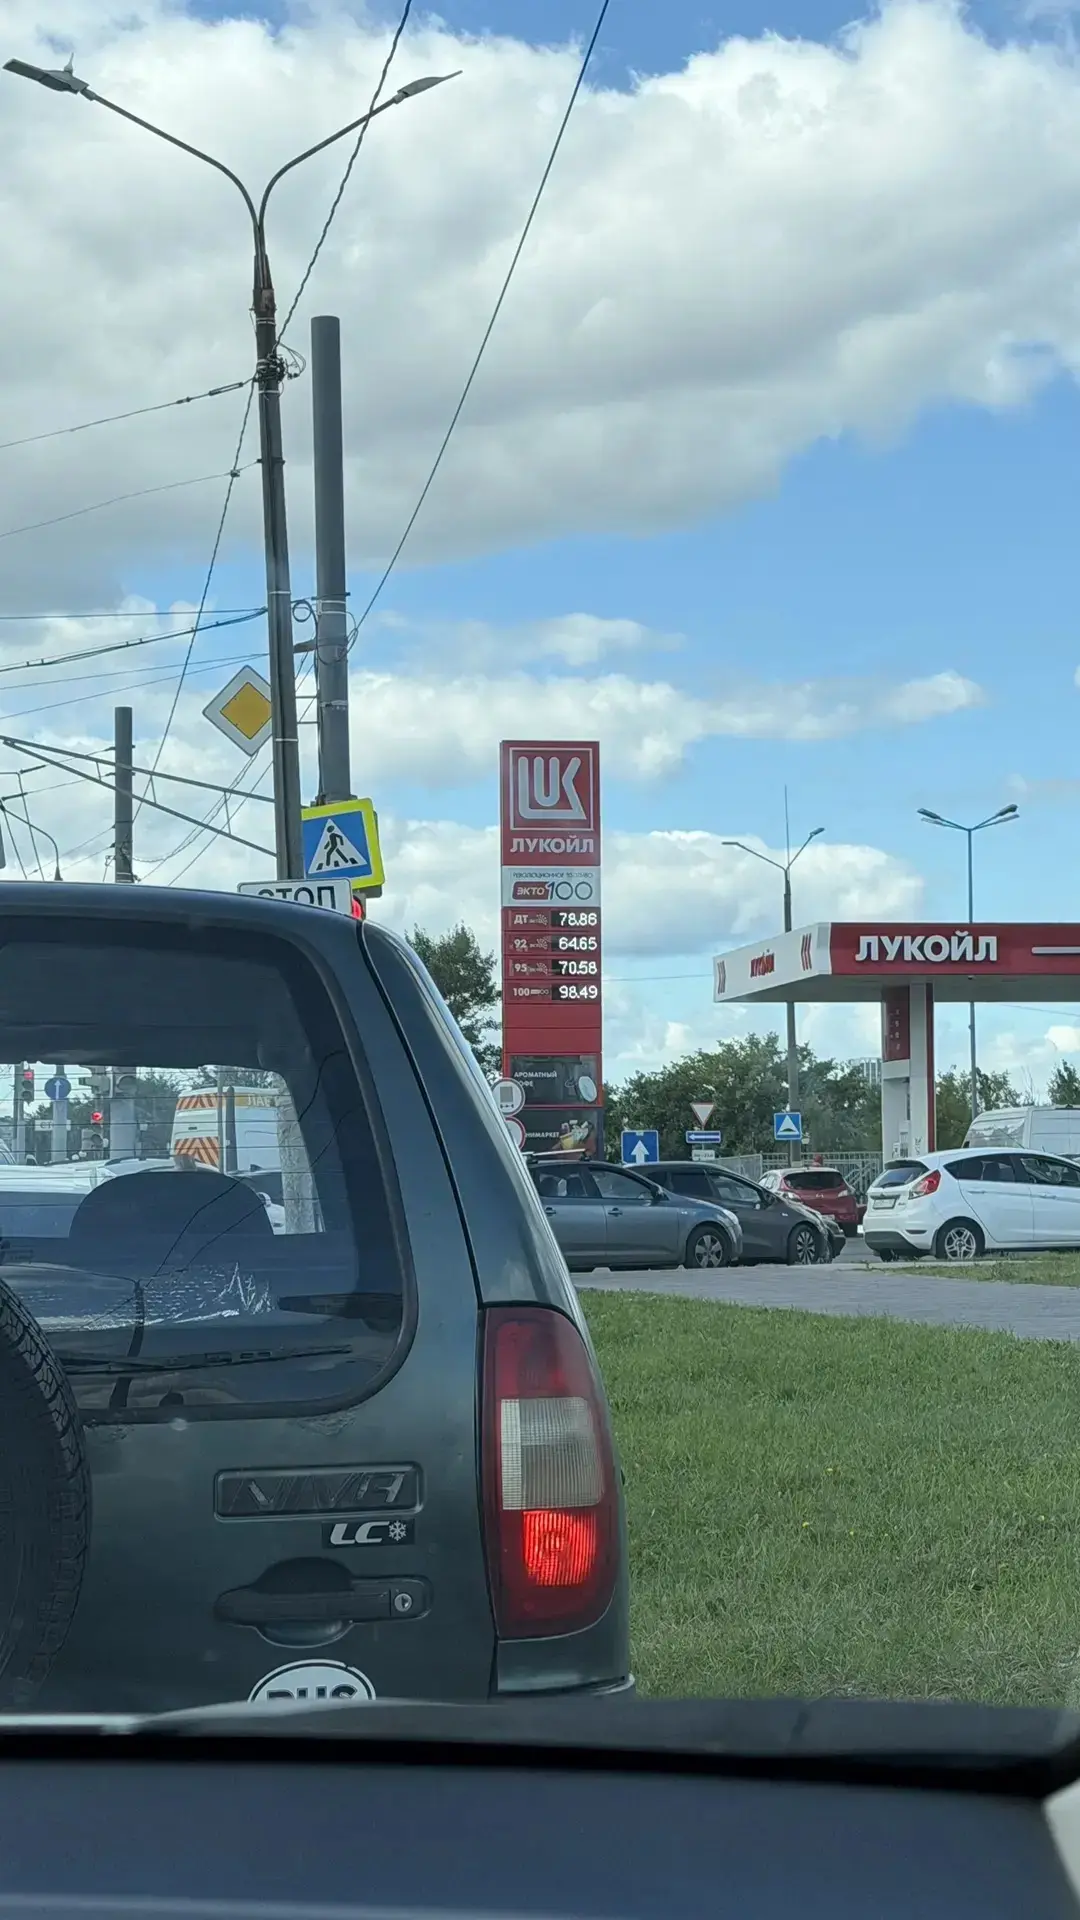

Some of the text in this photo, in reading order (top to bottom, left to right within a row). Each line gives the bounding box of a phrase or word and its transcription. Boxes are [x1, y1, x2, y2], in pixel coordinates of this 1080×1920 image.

[510, 835, 594, 853] ЛУКОЙЛ
[517, 887, 545, 895] ЭКТО
[514, 914, 528, 924] ДТ
[559, 912, 597, 926] 78.86
[514, 939, 527, 948] 92
[558, 937, 597, 950] 64.65
[855, 930, 997, 963] ЛУКОЙЛ
[514, 964, 527, 972] 95
[558, 961, 597, 975] 70.58
[513, 988, 530, 996] 100
[559, 985, 598, 999] 98.49
[514, 1070, 557, 1078] АРОМАТНЫЙ
[330, 1521, 390, 1545] LC
